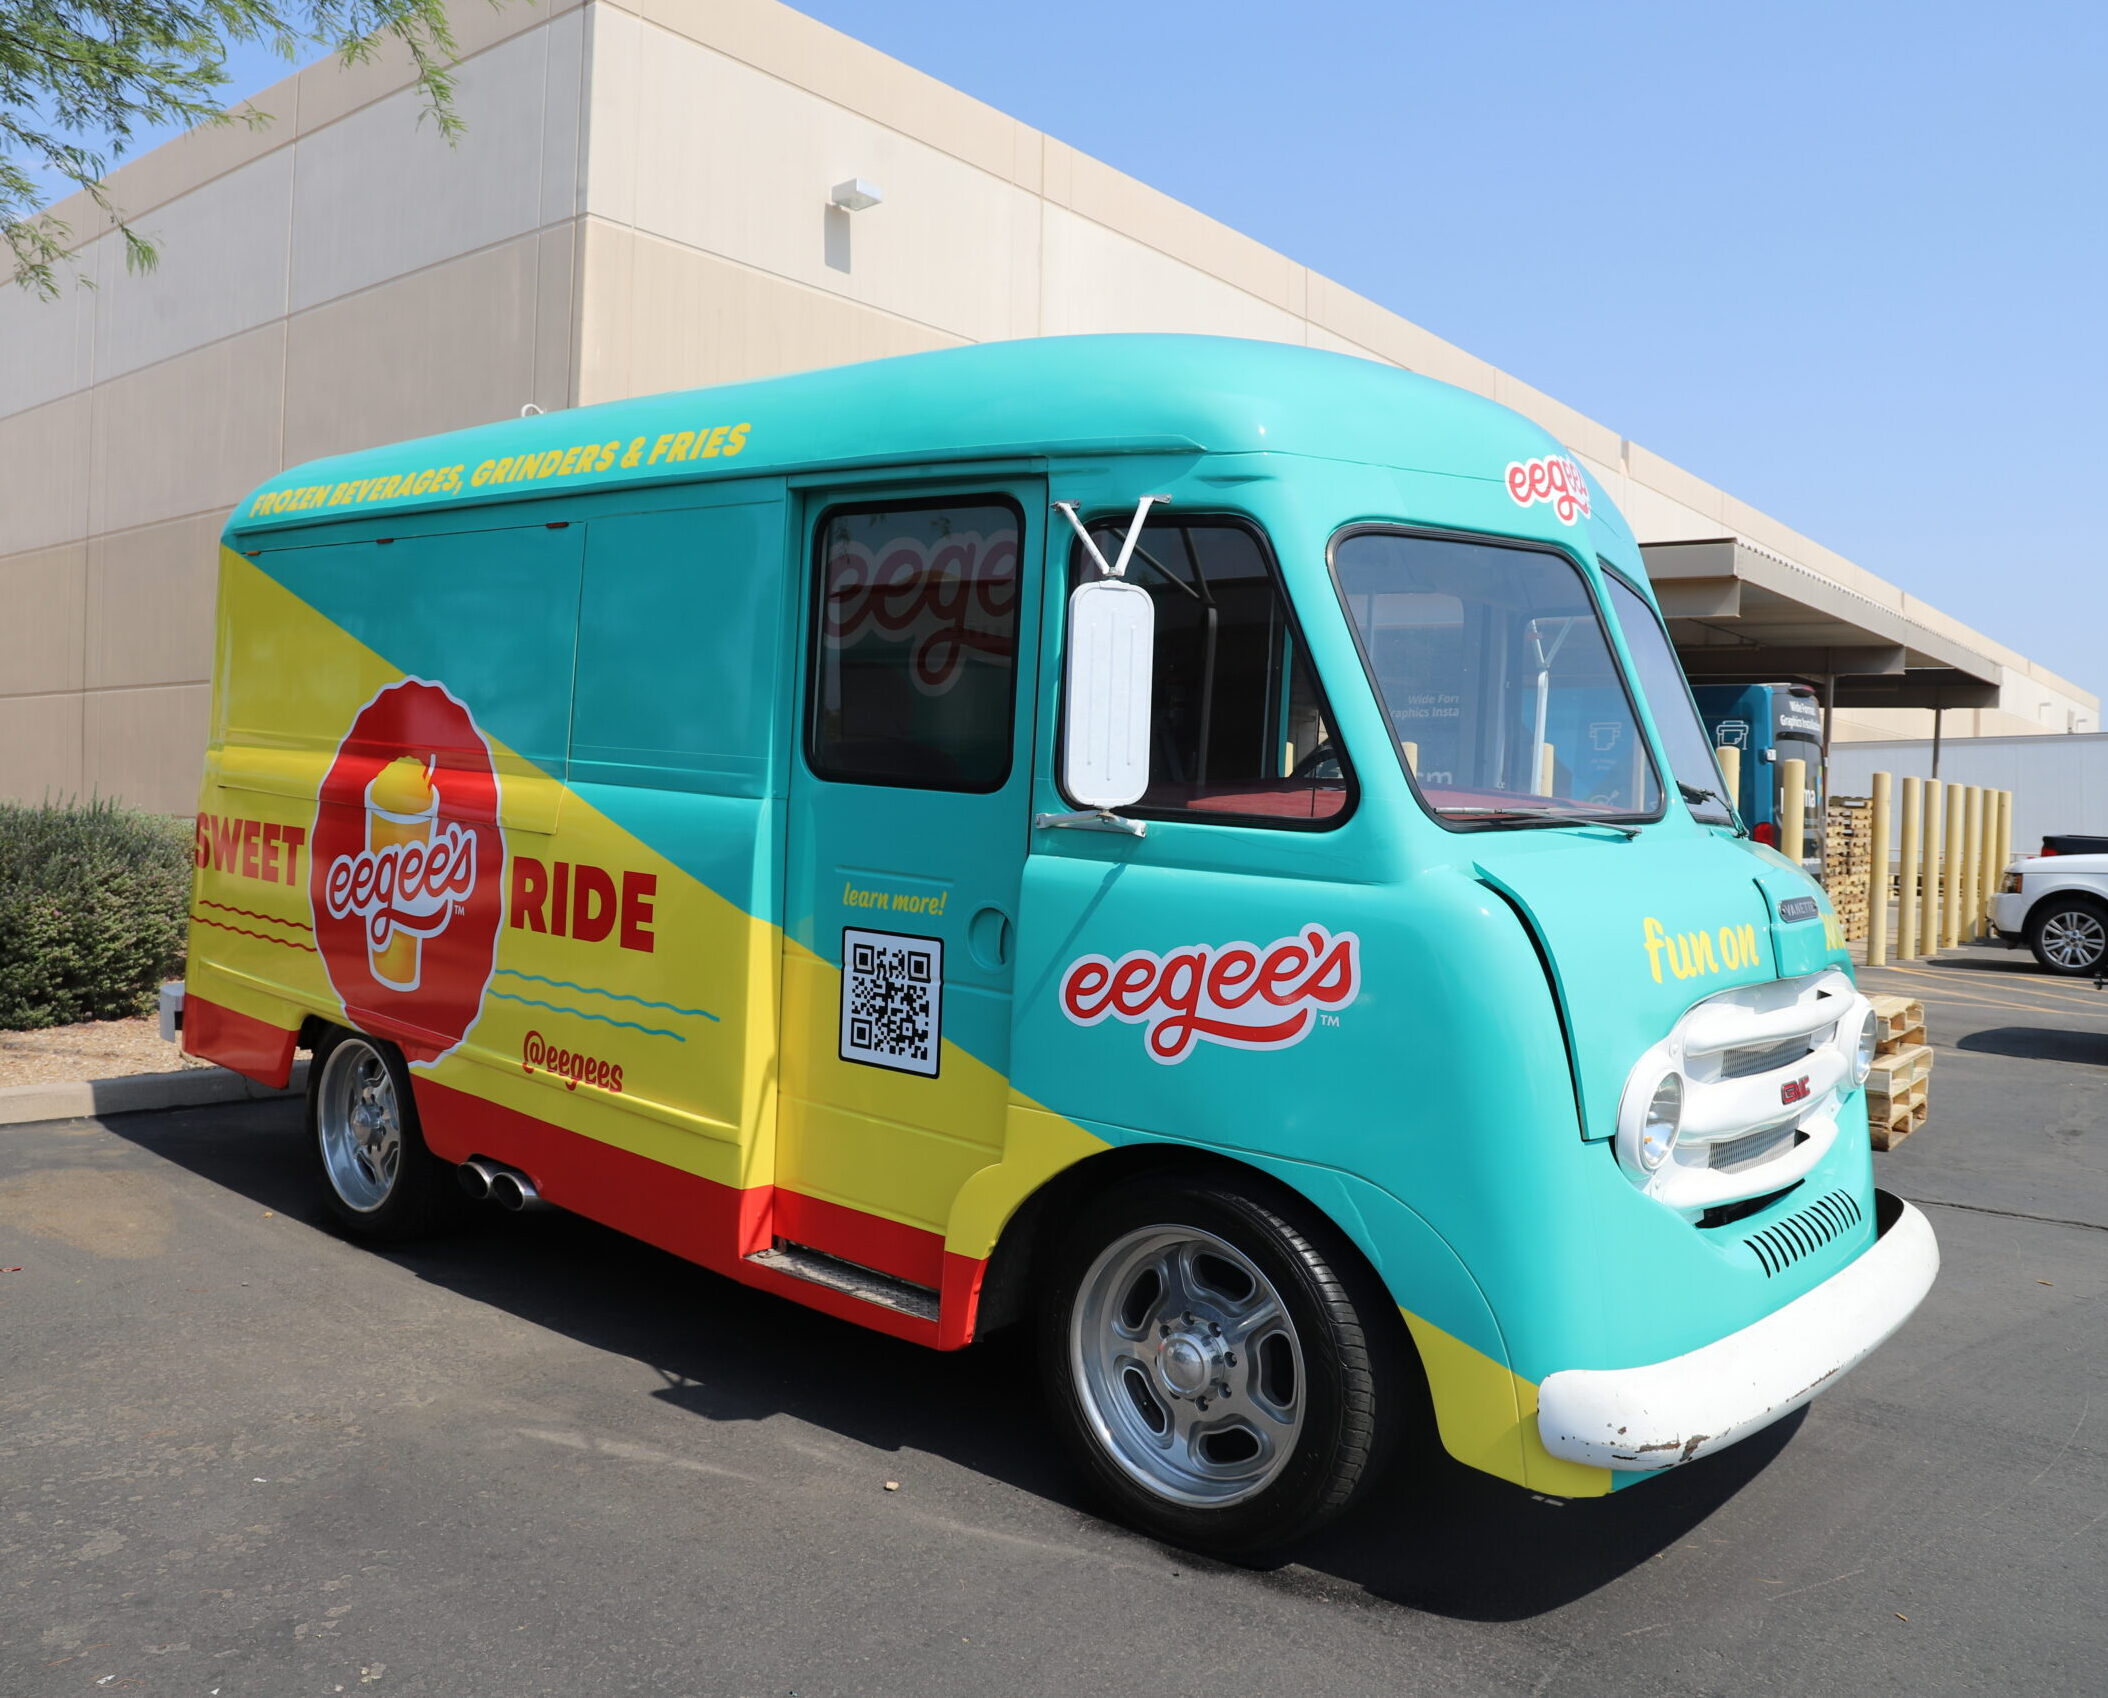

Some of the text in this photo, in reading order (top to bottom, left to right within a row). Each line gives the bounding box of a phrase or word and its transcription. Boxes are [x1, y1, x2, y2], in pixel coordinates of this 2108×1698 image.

[249, 422, 752, 518] FROZEN BEVERAGES, GRINDERS & FRIES
[1389, 706, 1430, 720] raphics
[195, 812, 306, 887] SWEET
[327, 828, 475, 946] eegee's TM
[510, 856, 657, 953] RIDE
[843, 881, 948, 916] learn more!
[1643, 916, 1719, 984] fun
[1719, 922, 1760, 972] on
[1064, 931, 1353, 1058] eegee's TM
[522, 1030, 624, 1092] @eegees
